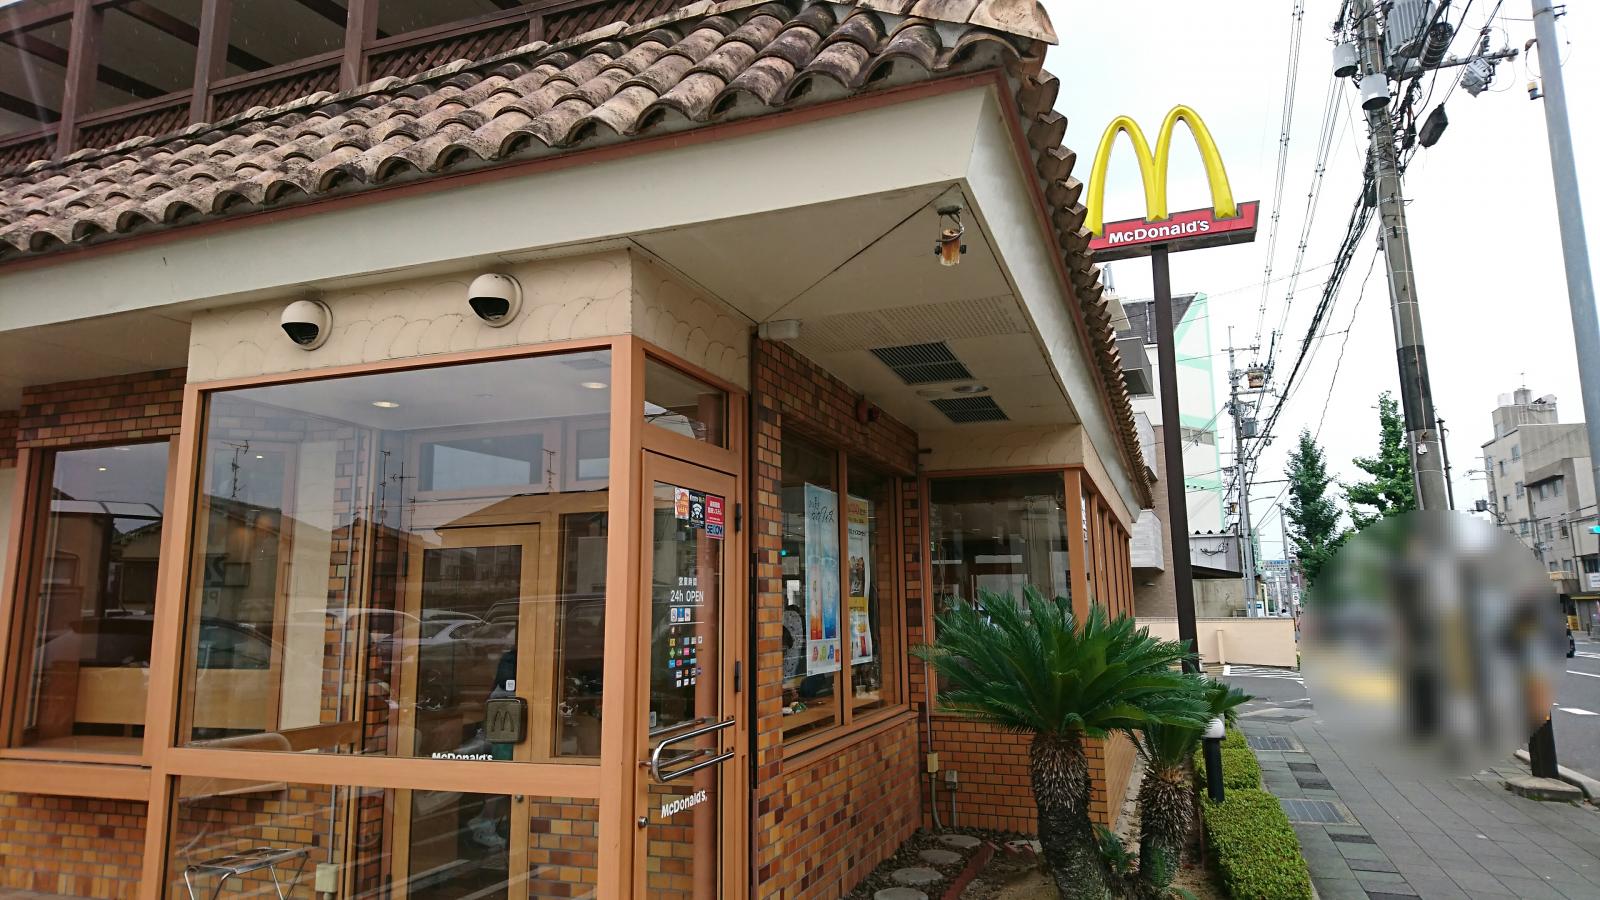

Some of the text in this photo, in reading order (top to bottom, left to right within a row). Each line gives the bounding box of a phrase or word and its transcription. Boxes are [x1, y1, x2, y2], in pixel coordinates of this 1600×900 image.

[1108, 220, 1210, 244] McDonald's
[670, 590, 704, 602] 24h OPEN
